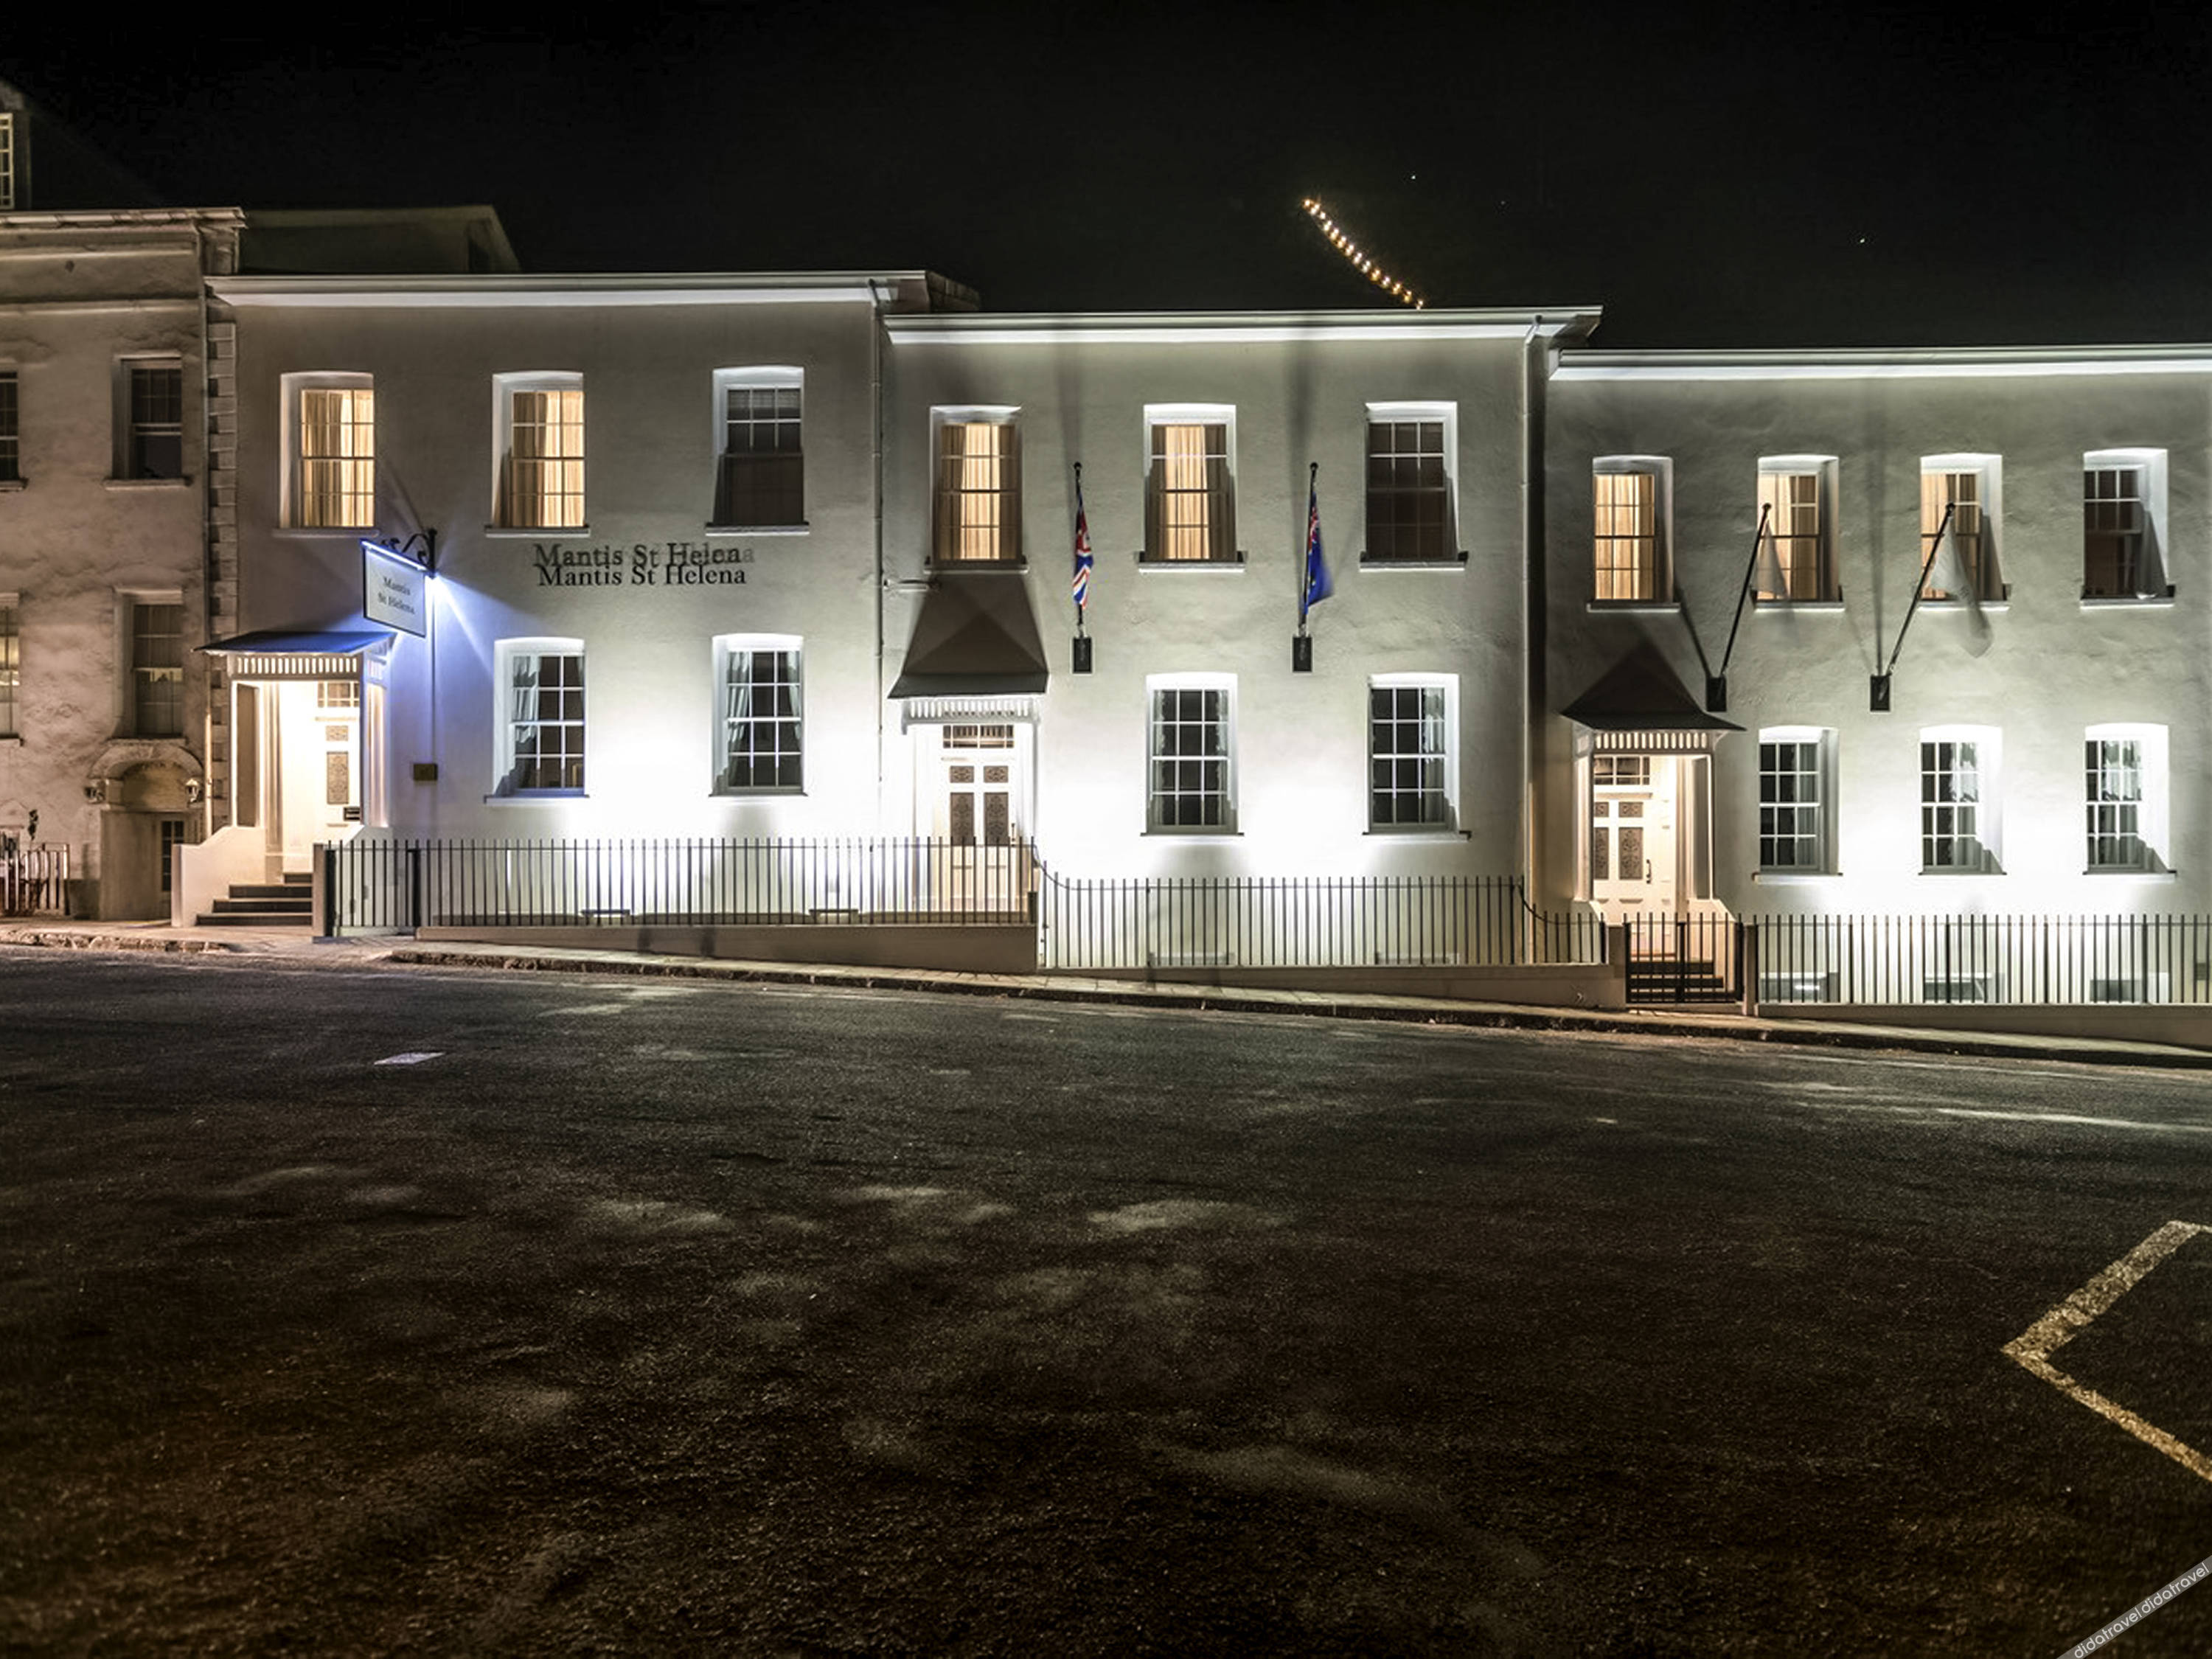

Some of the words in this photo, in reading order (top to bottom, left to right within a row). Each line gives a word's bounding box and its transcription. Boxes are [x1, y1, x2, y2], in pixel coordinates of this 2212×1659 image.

[536, 563, 622, 586] Mantis
[631, 566, 655, 585] St
[665, 564, 746, 585] Helena
